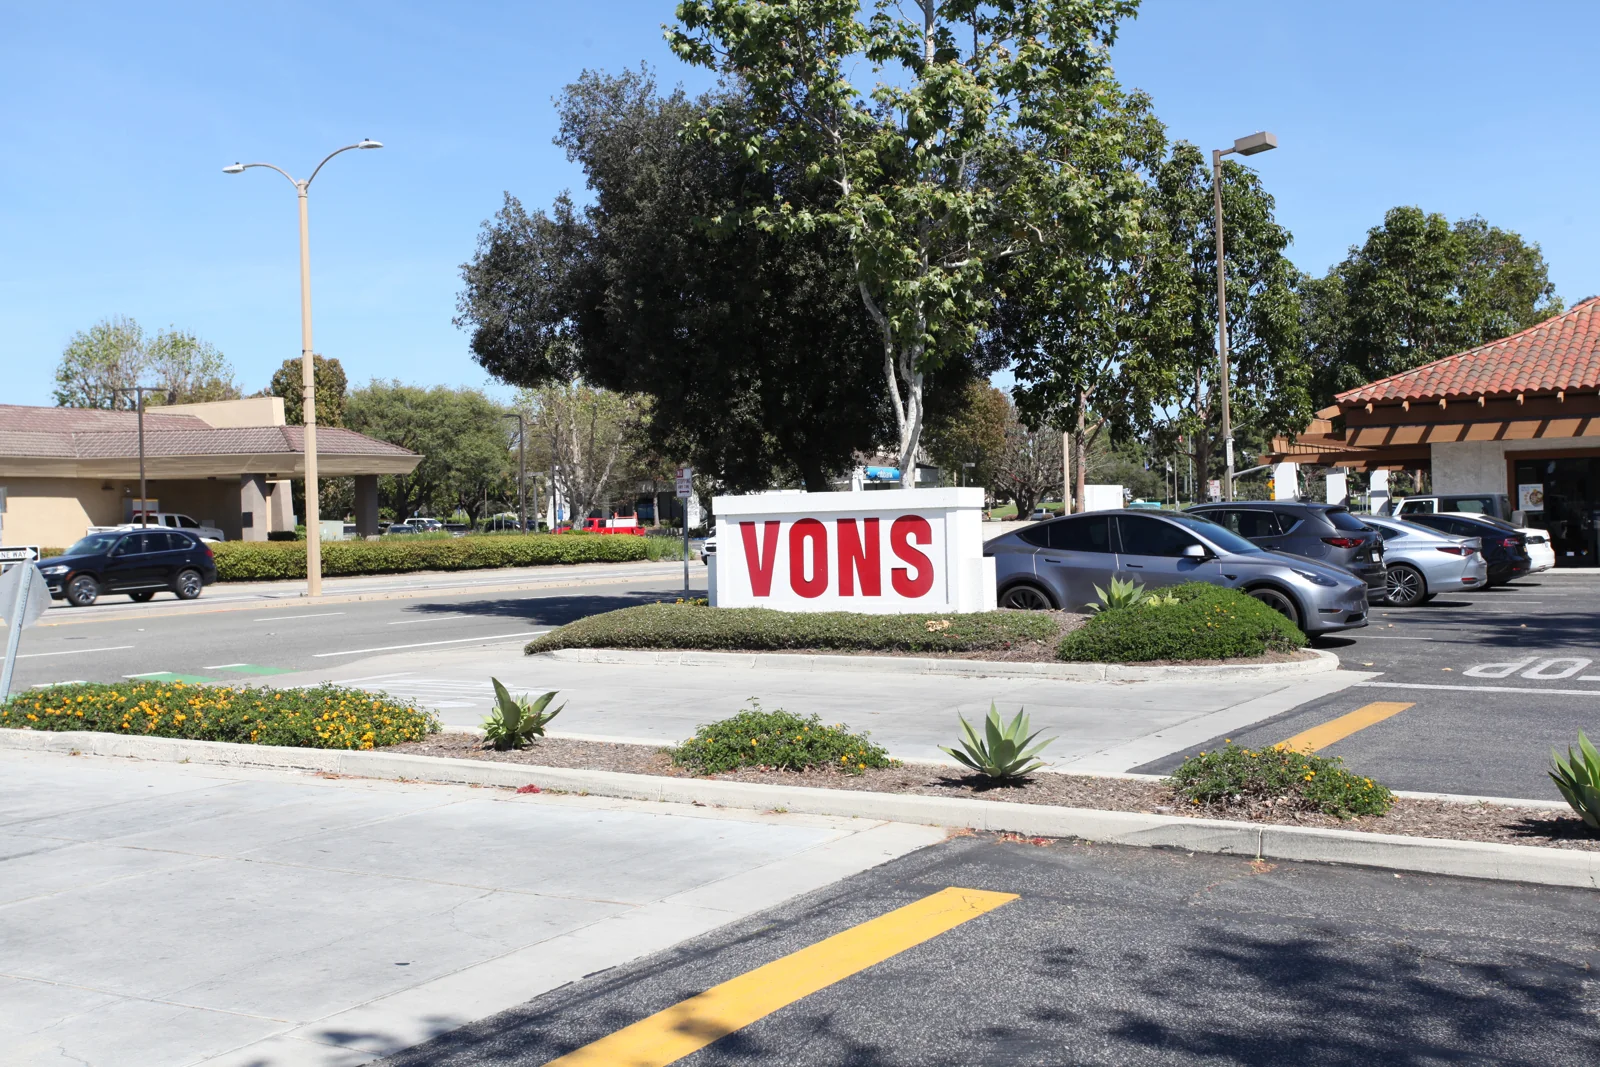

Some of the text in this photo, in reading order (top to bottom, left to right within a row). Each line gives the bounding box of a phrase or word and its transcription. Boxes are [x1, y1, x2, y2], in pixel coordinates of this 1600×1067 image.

[1, 551, 10, 559] NE
[739, 514, 934, 598] VONS
[1463, 656, 1600, 680] OP
